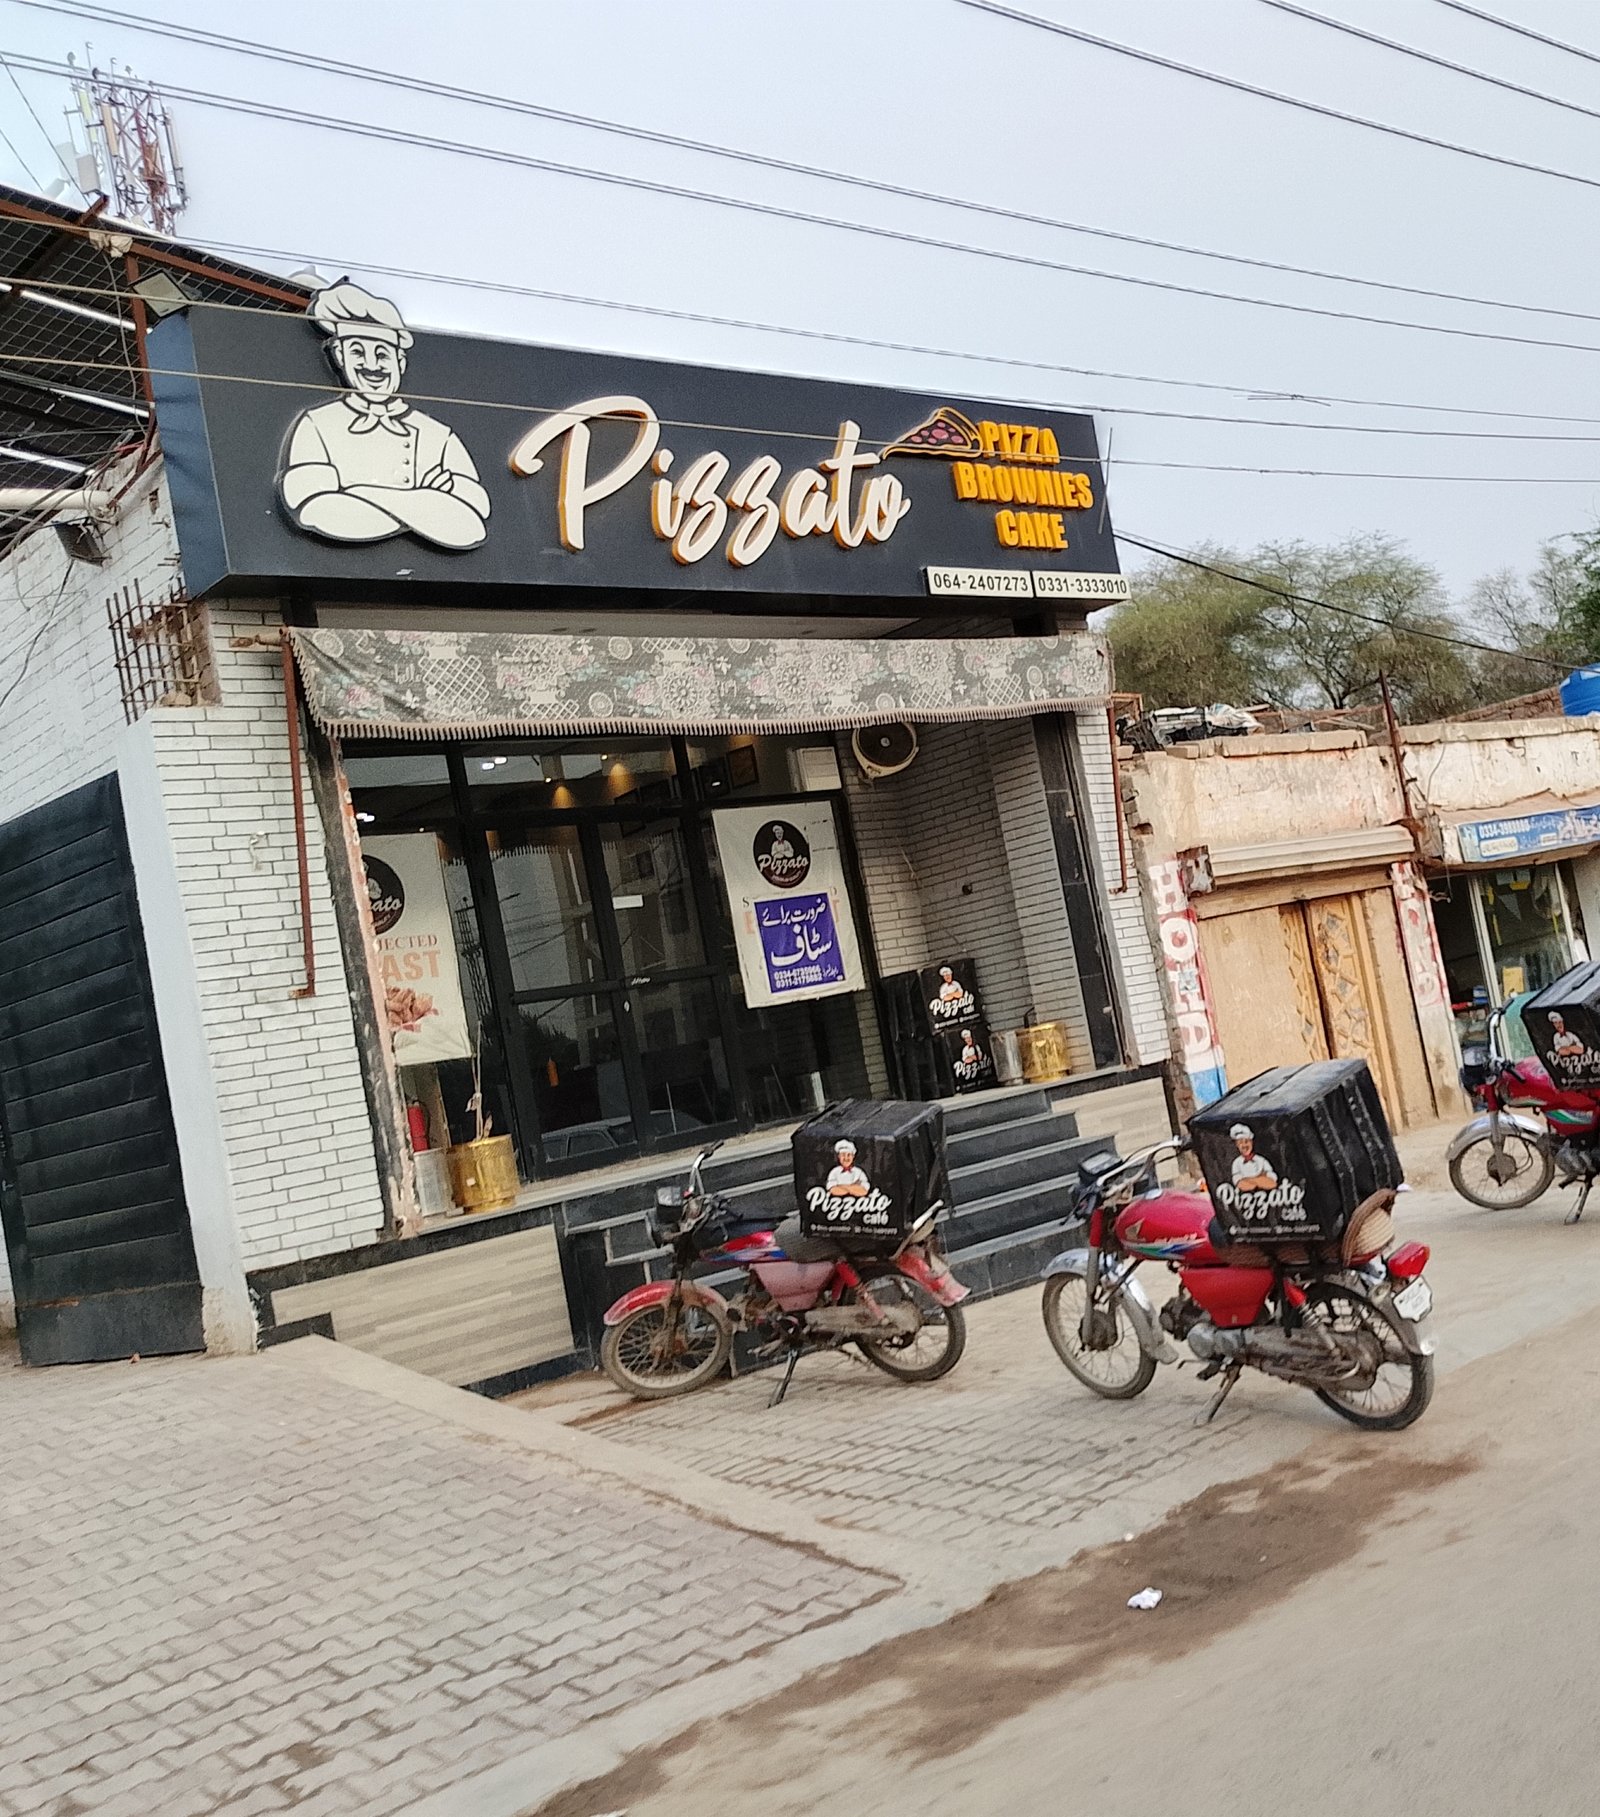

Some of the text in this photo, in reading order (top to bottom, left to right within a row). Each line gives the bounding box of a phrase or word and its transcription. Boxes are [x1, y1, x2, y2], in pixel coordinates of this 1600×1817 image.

[978, 420, 1060, 464] PIZZA
[508, 394, 912, 567] Pizzato
[953, 461, 1093, 509] BROWNIES
[995, 509, 1068, 549] CAKE
[933, 572, 1127, 594] 064-2407273 0331-3333010
[758, 853, 809, 875] Pizzato
[929, 990, 975, 1018] Pizzato
[805, 1187, 893, 1221] Pizzato
[1216, 1177, 1306, 1220] Pizzato
